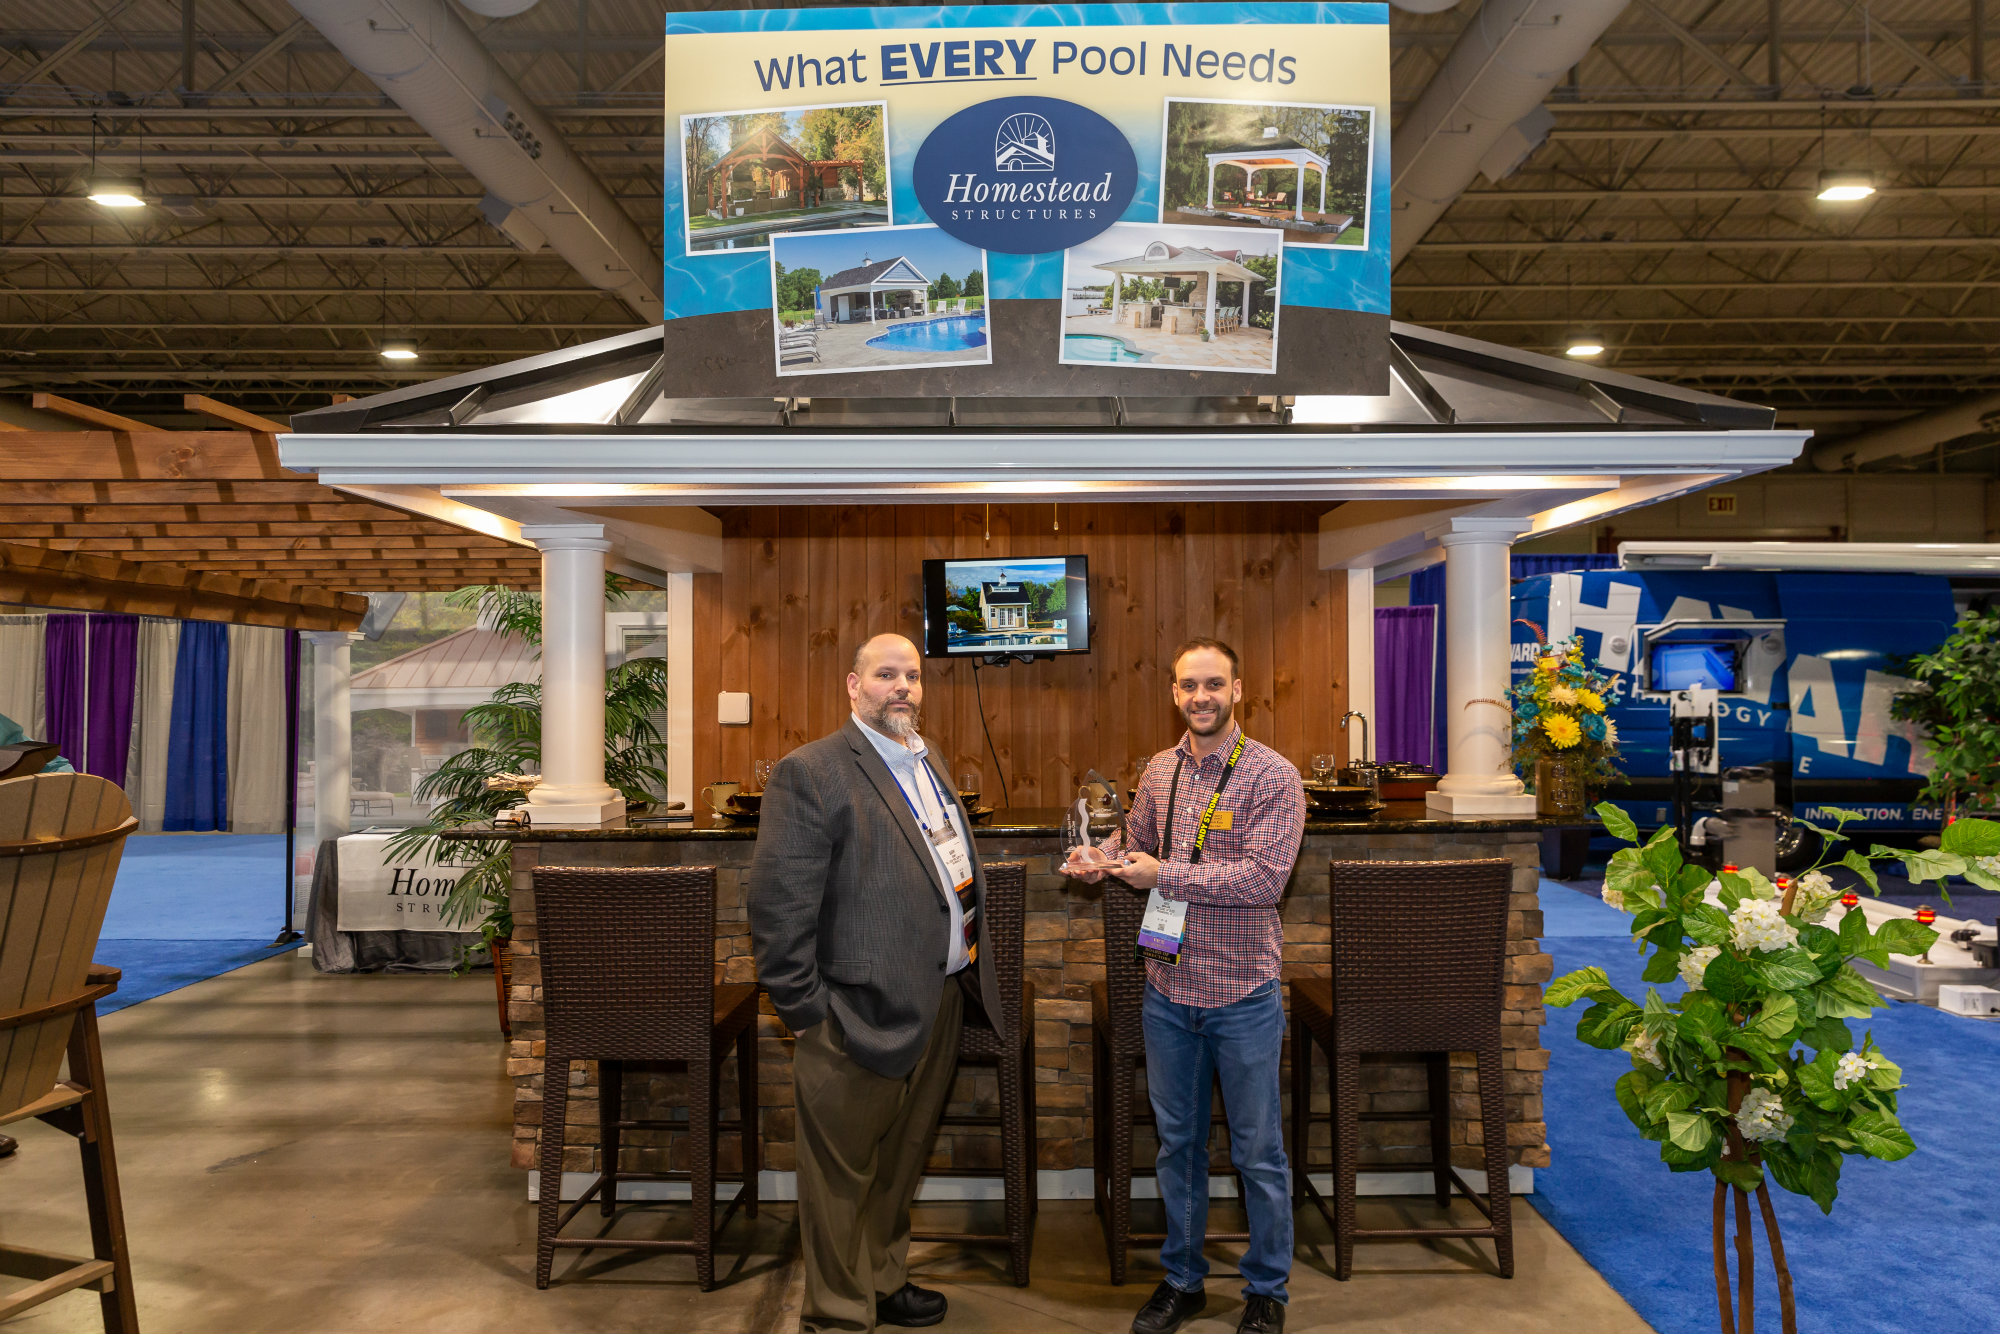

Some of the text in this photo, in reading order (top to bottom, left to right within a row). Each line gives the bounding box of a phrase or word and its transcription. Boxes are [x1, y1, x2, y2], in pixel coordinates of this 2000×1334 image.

[754, 38, 1297, 92] What EVERY Pool Needs
[943, 172, 1112, 203] Homestead
[951, 209, 1096, 220] STRUCTURES
[1709, 497, 1734, 511] EXIT
[1195, 823, 1208, 851] JANDY
[1203, 792, 1221, 824] STRONG
